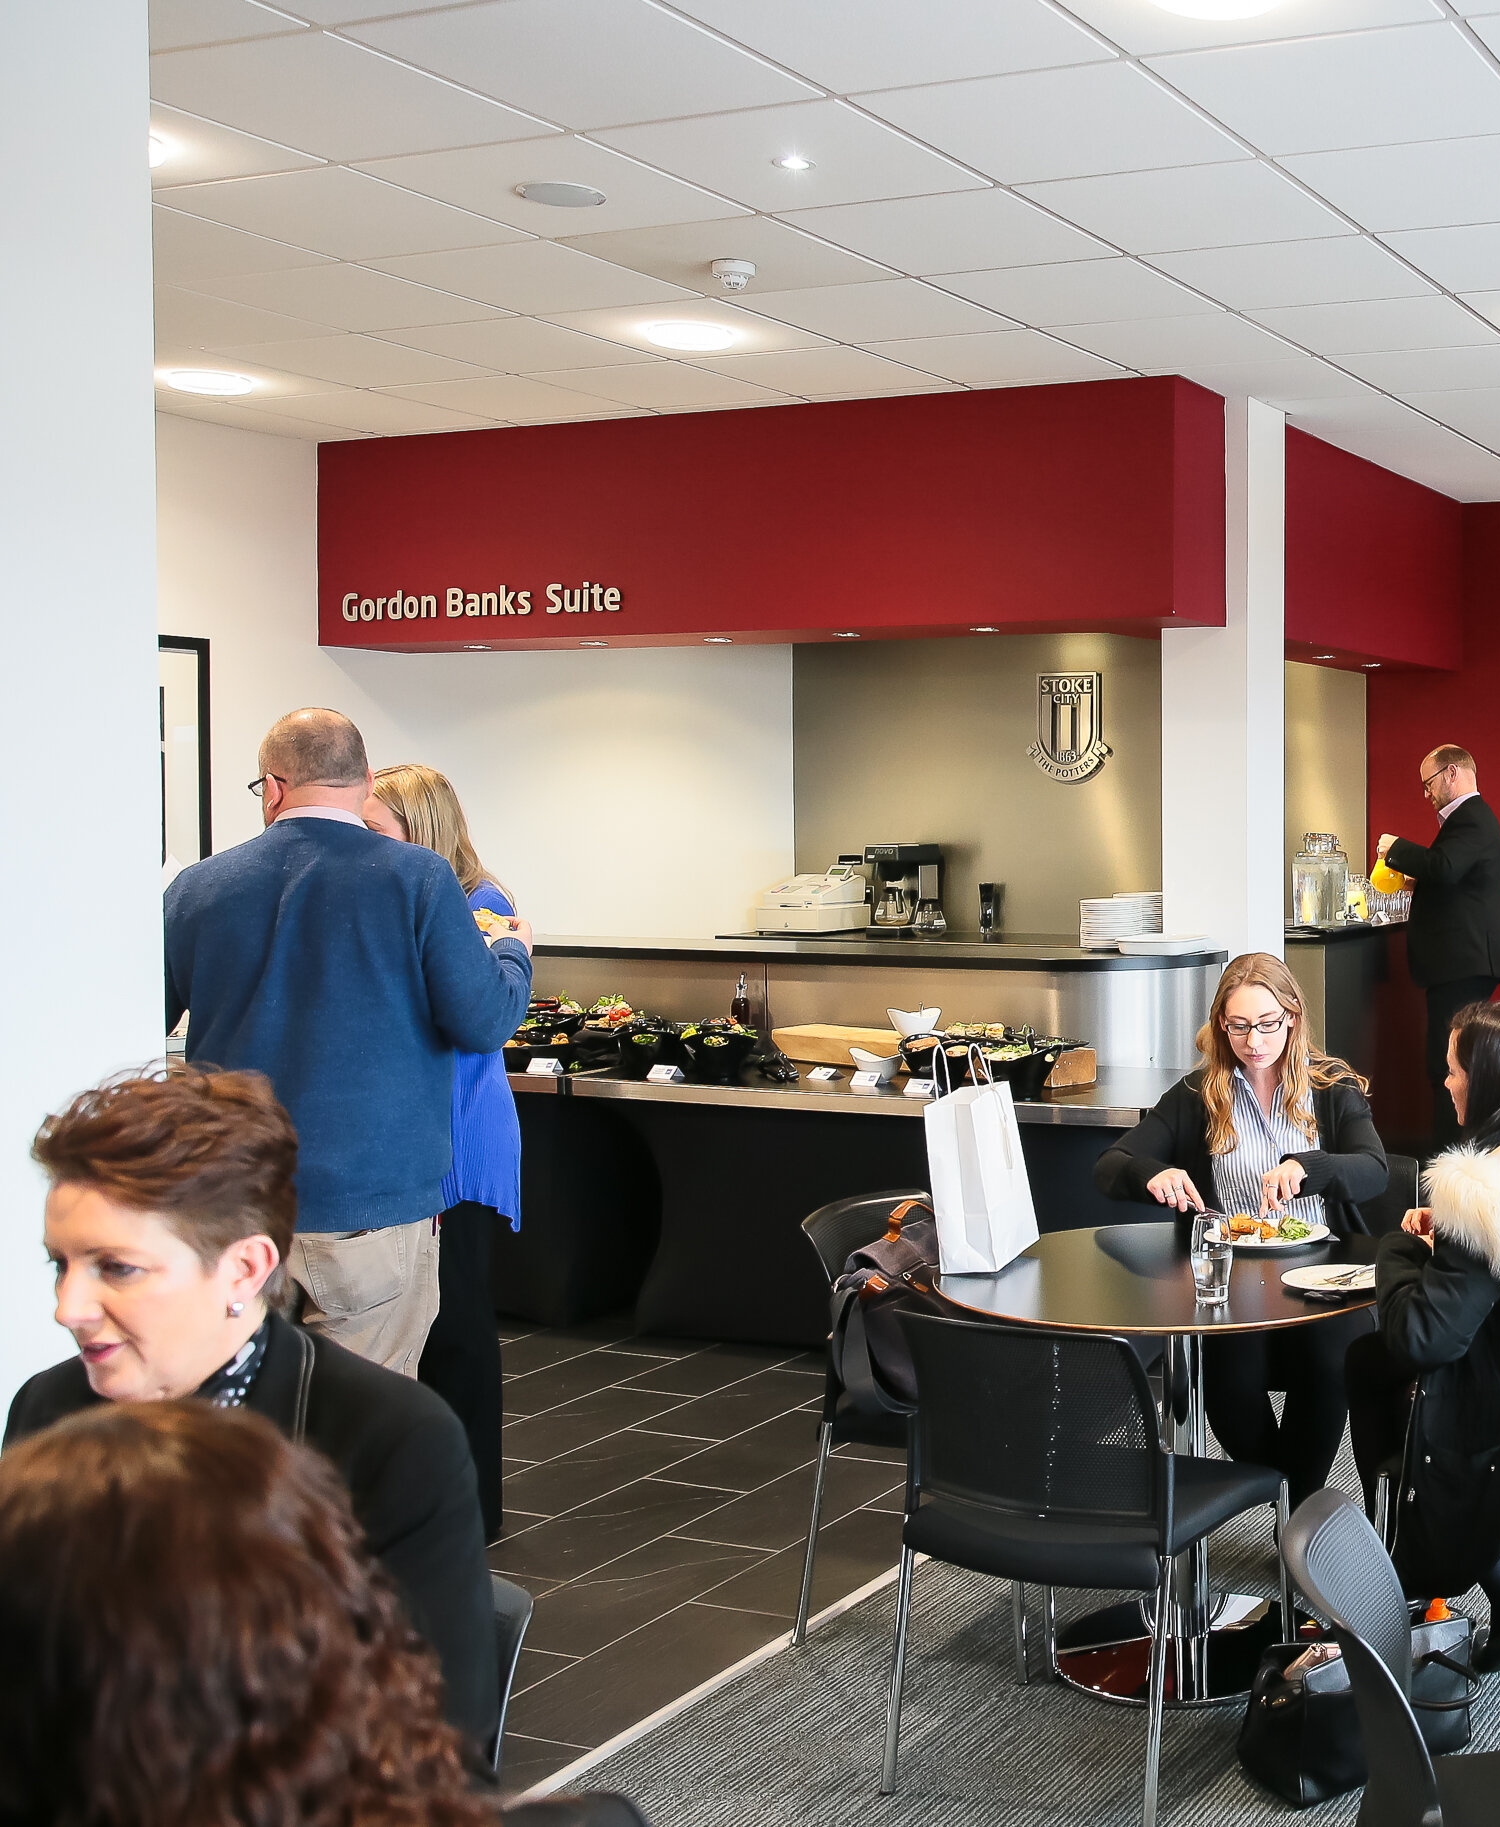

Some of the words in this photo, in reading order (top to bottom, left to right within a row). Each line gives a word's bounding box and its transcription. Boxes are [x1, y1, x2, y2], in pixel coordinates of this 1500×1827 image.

[342, 590, 437, 622] Gordon
[446, 584, 532, 617] Banks
[545, 581, 621, 614] Suite
[1041, 678, 1092, 693] STOKE
[1053, 693, 1080, 704] CITY
[1056, 751, 1077, 762] 1863
[1038, 756, 1053, 772] THE
[1055, 757, 1094, 777] POTTERS
